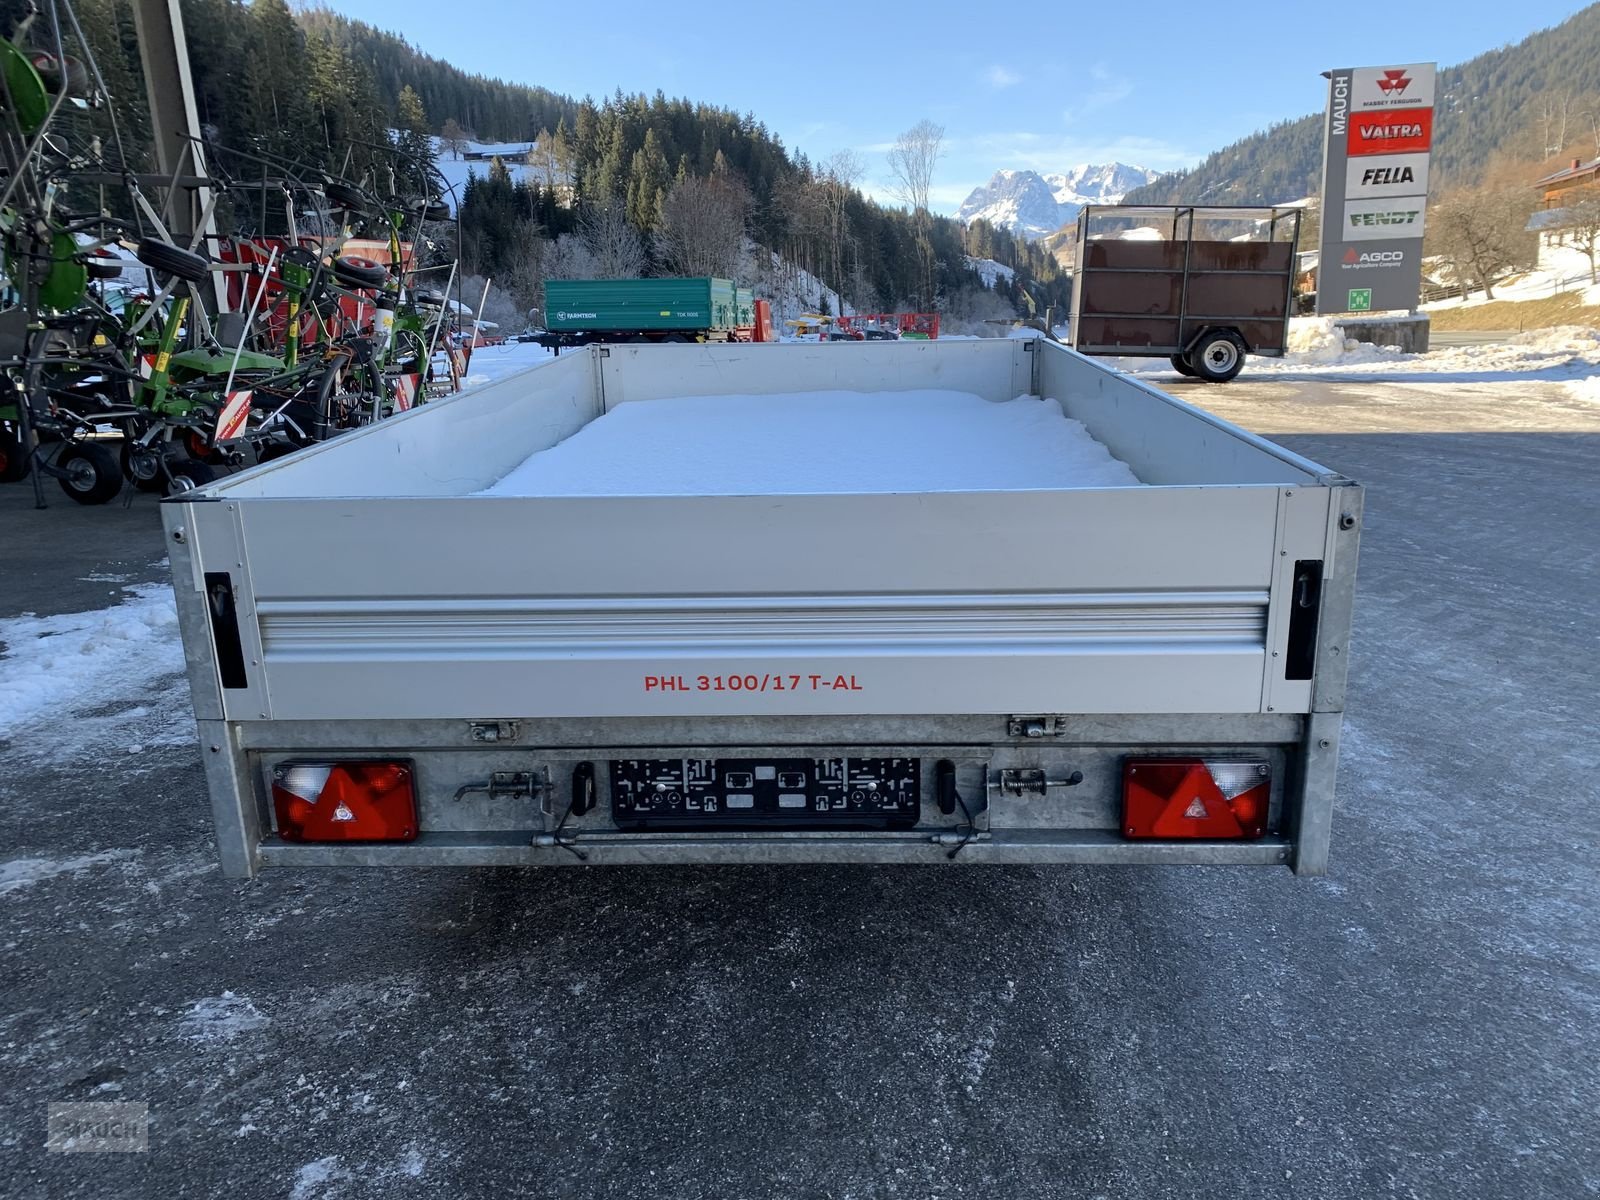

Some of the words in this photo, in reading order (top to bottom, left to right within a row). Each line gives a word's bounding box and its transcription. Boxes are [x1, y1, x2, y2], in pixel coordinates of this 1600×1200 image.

[1332, 76, 1348, 136] MAUCH
[1359, 124, 1422, 139] VALTRA
[1361, 166, 1415, 186] FELLA
[1350, 211, 1420, 227] FENDT
[1359, 251, 1404, 262] AGCO
[644, 676, 690, 691] PHL
[696, 674, 801, 692] 3100/17
[808, 675, 863, 691] T-AL
